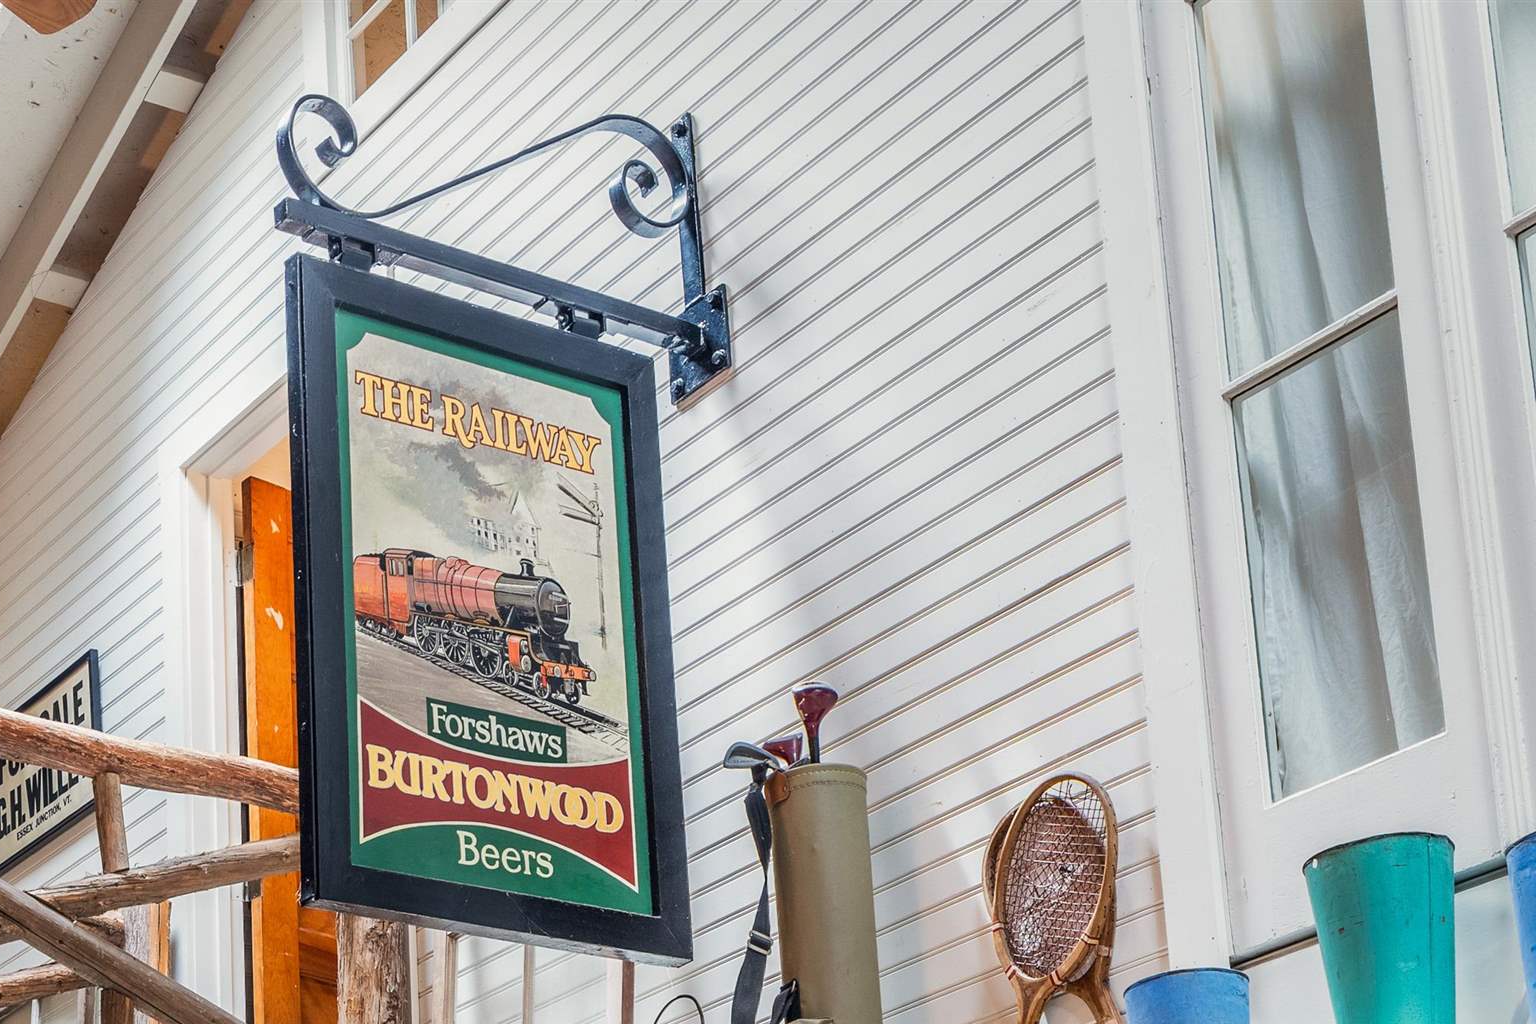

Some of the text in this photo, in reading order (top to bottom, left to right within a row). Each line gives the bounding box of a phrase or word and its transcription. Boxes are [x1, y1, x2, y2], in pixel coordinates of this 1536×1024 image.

[354, 369, 602, 475] THE RAILWAY
[39, 679, 85, 726] ALE
[429, 702, 564, 759] Forshaws
[365, 743, 625, 834] BURTONWOOD
[16, 822, 34, 841] ESSEX
[455, 829, 555, 879] Beers
